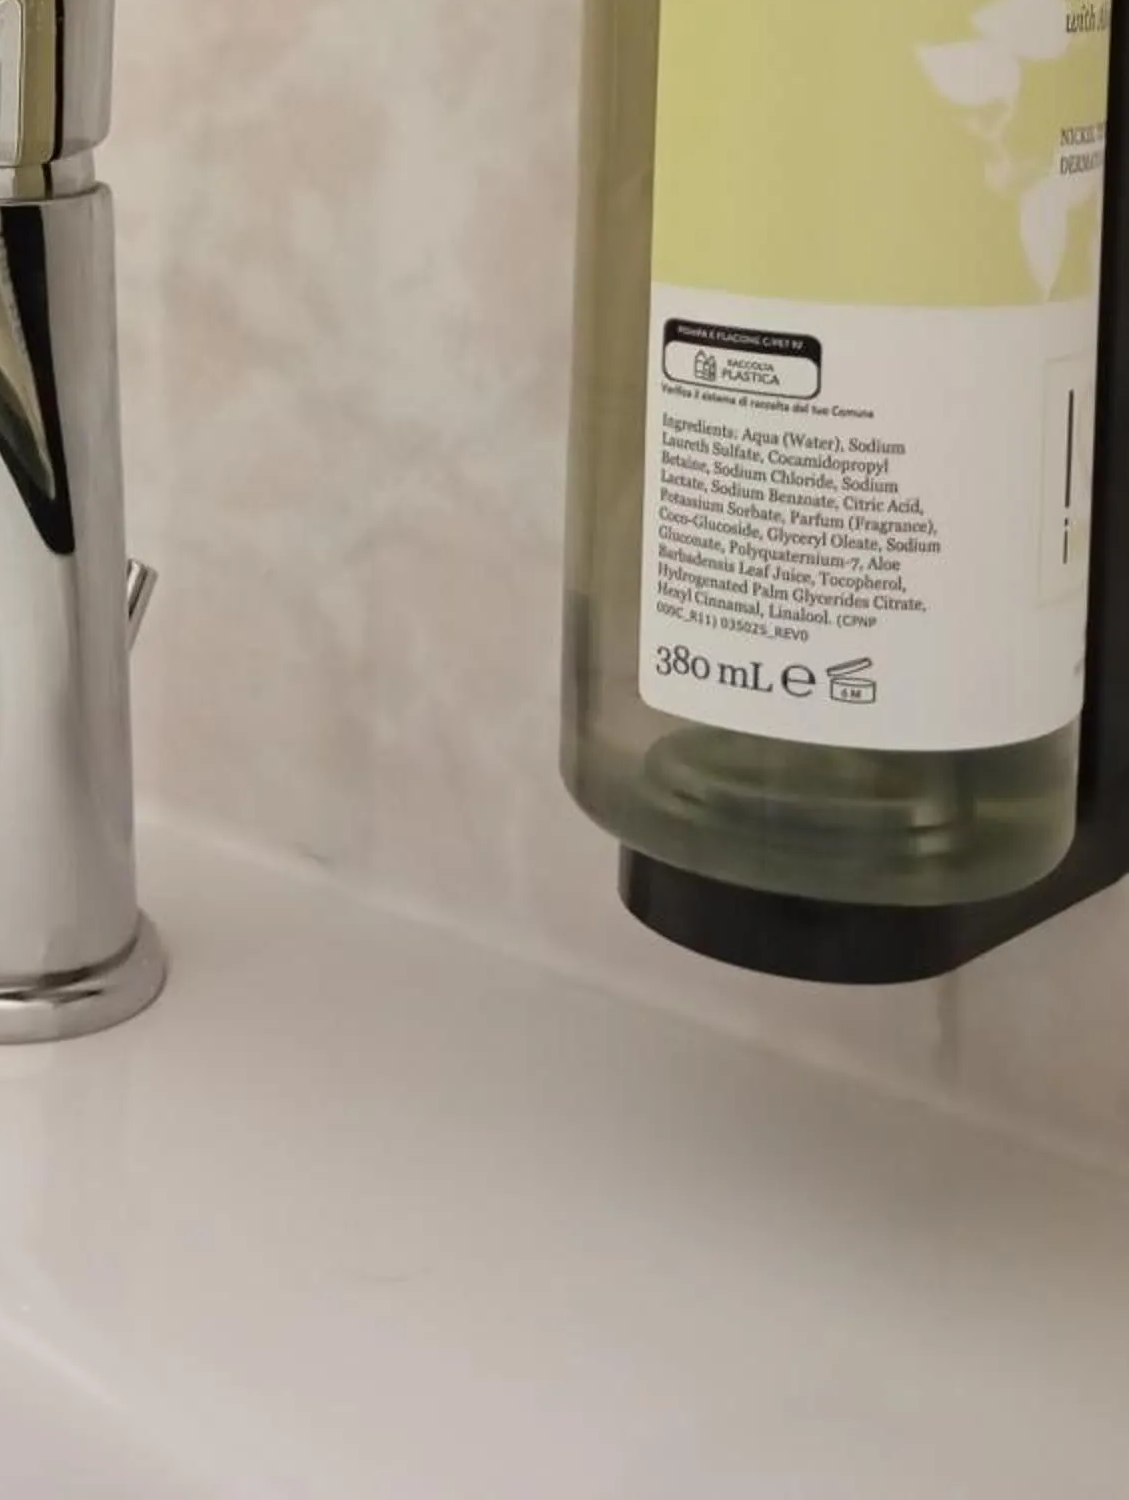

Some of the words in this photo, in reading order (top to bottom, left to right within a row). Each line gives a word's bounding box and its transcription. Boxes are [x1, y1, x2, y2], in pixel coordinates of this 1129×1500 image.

[721, 368, 780, 386] PLASTICA
[727, 358, 774, 372] RACCOLTA
[662, 411, 739, 440] Ingredients:
[742, 428, 779, 446] Aqua
[782, 431, 844, 453] (Water),
[848, 437, 906, 455] Sodium
[832, 405, 874, 419] Comune
[662, 431, 709, 454] Laureth
[712, 442, 764, 464] Sulfate,
[768, 449, 889, 476] Cocamidopropyl
[662, 451, 710, 475] Betaine,
[714, 461, 766, 482] Sodium
[770, 469, 838, 492] Chloride,
[841, 476, 898, 494] Sodium
[660, 487, 723, 514] Potassium
[727, 501, 786, 525] Sorbate,
[790, 510, 844, 529] Parfum
[848, 515, 937, 536] (Fragrance),
[661, 468, 708, 493] Lactate,
[711, 479, 764, 502] Sodium
[768, 488, 840, 510] Benzoate,
[843, 495, 885, 513] Citric
[887, 497, 924, 516] Acid,
[658, 505, 763, 541] Coco-Glucoside,
[766, 527, 826, 549] Glyceryl
[830, 533, 883, 552] Oleate,
[886, 536, 941, 554] Sodium
[658, 525, 726, 554] Gluconate,
[729, 539, 864, 571] Polyquaternium-7,
[867, 555, 901, 572] Aloe
[658, 543, 735, 573] Barbadensis
[738, 561, 770, 579] Leaf
[772, 565, 816, 587] Juice,
[819, 570, 907, 594] Tocopherol,
[658, 561, 748, 594] Hydrogenated
[752, 581, 788, 601] Palm
[792, 588, 869, 609] Glycerides
[873, 595, 927, 612] Citrate,
[657, 580, 692, 604] Hexyl
[694, 590, 765, 618] Cinnamal,
[655, 644, 711, 680] 380
[717, 661, 774, 693] mL
